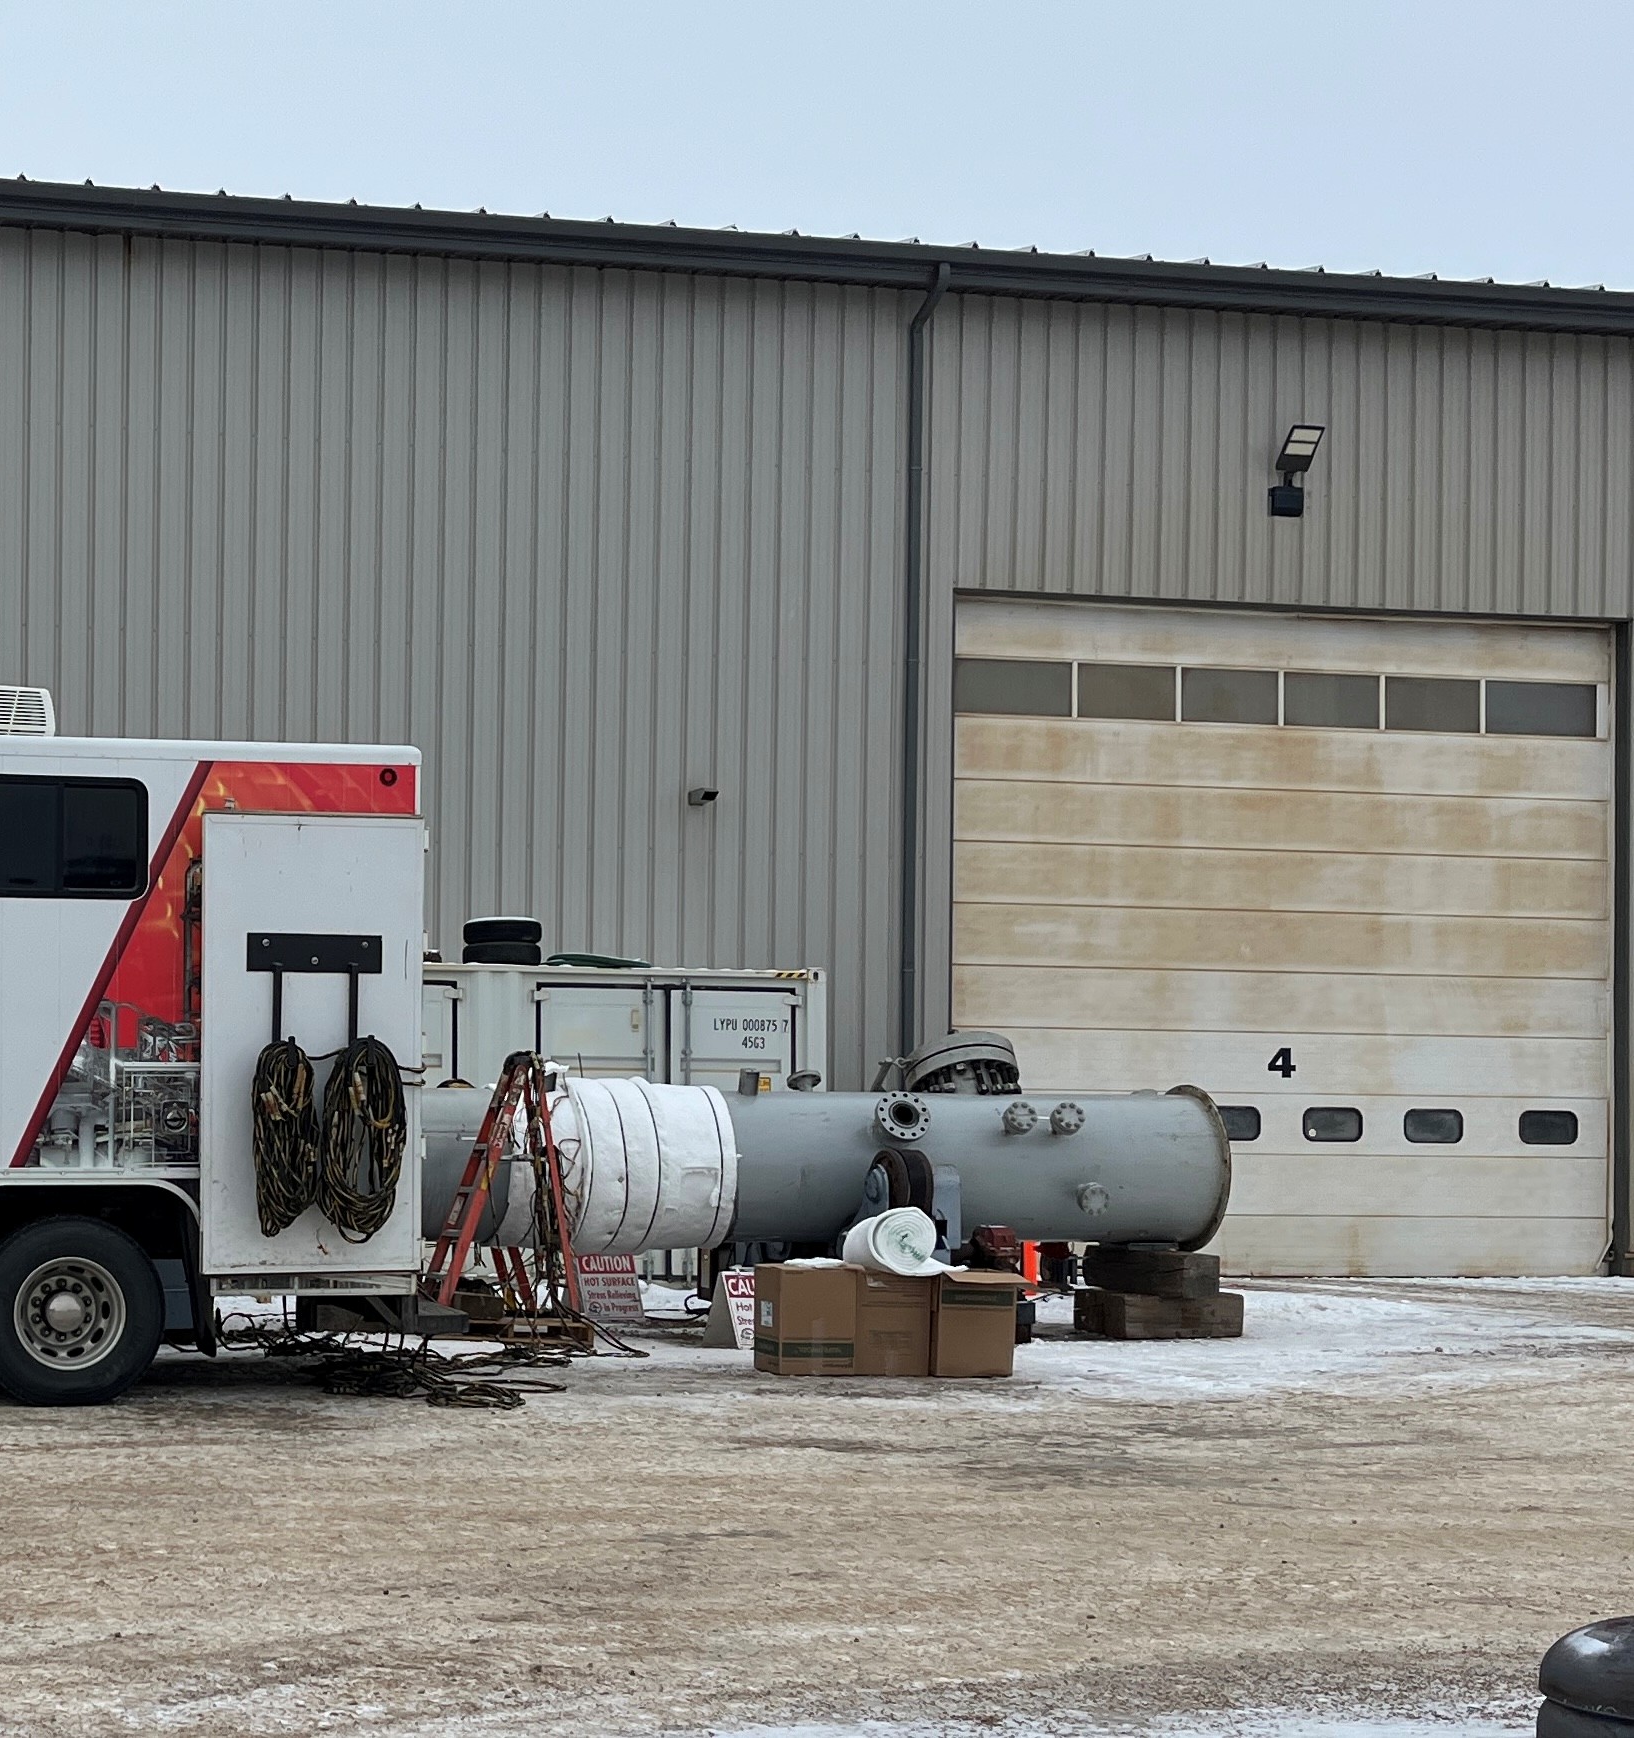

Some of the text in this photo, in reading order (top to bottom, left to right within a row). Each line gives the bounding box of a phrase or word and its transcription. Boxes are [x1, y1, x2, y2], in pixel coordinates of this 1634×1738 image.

[713, 1018, 789, 1033] LYPU 000875 7
[742, 1036, 765, 1049] 45G3
[1268, 1048, 1296, 1078] 4
[581, 1255, 632, 1272] CAUTION
[584, 1277, 635, 1286] HOT SURFACE
[587, 1290, 606, 1299] Stress
